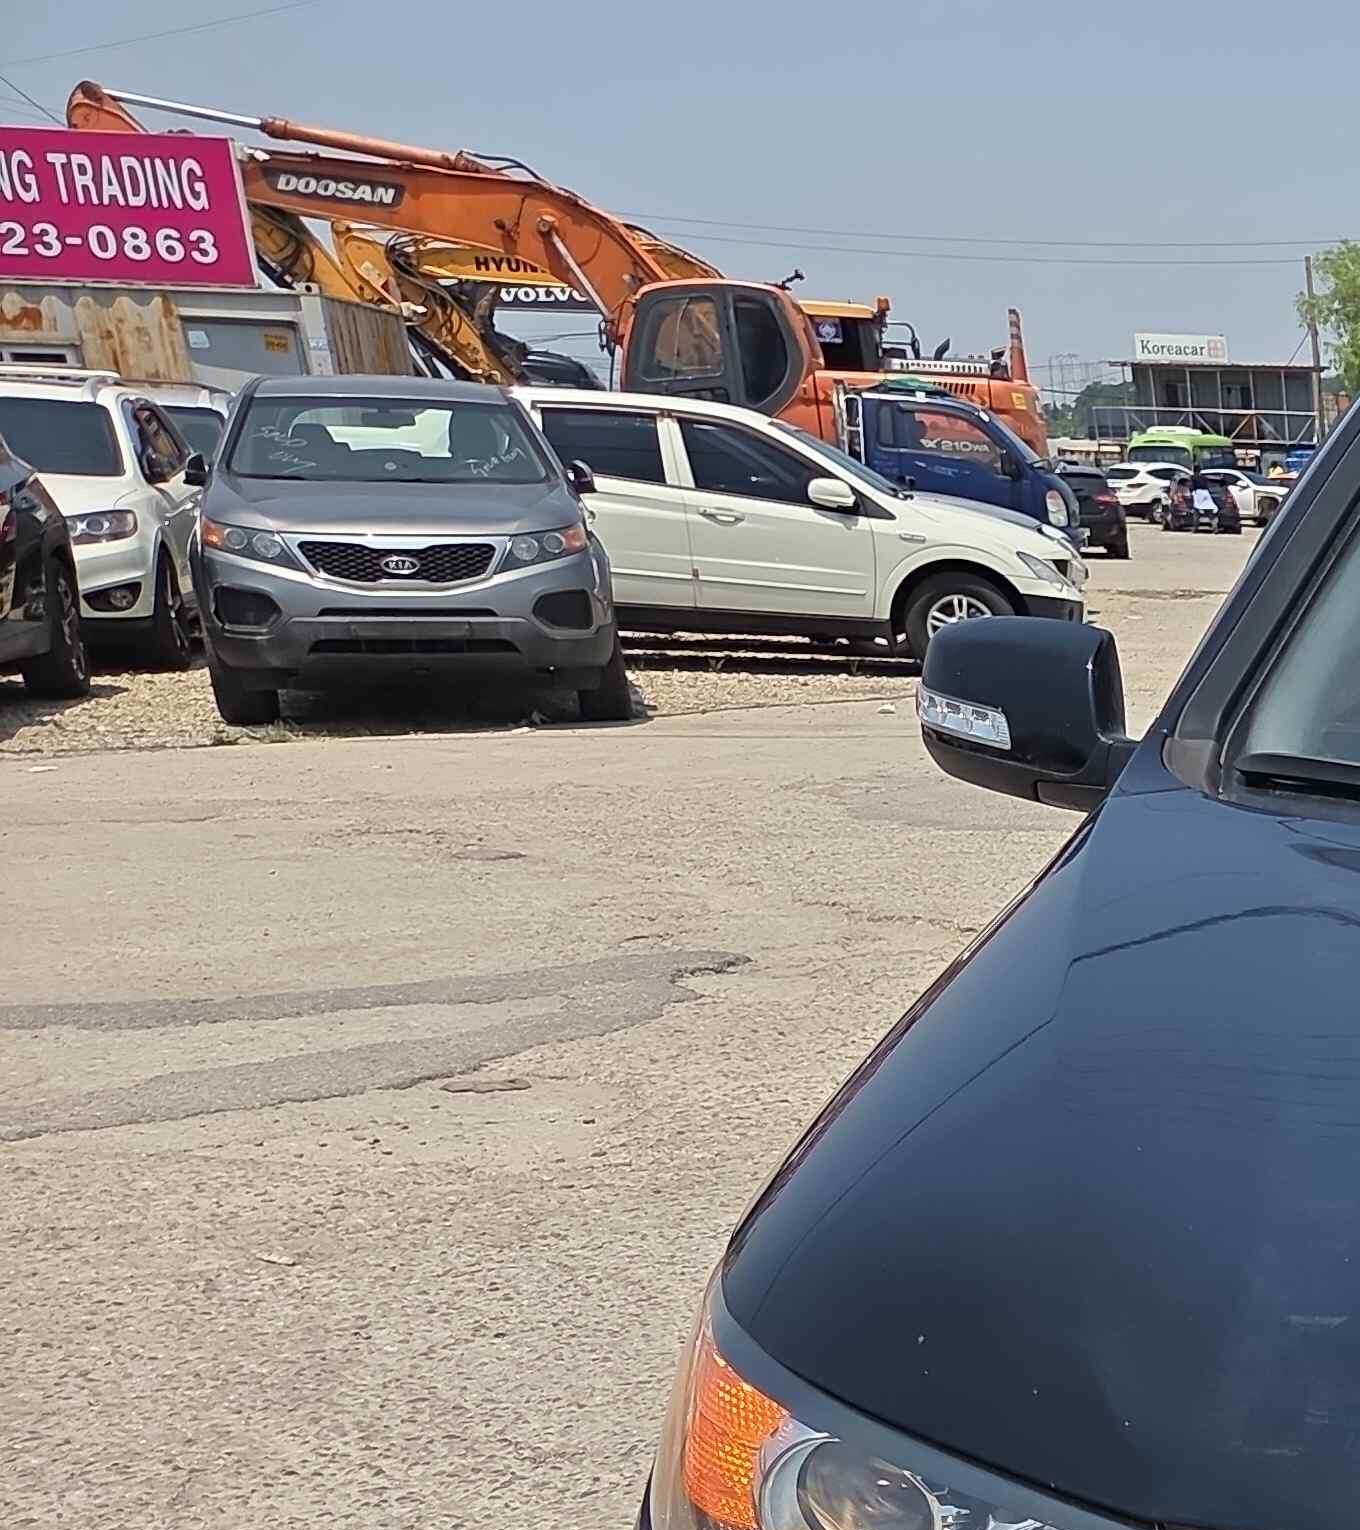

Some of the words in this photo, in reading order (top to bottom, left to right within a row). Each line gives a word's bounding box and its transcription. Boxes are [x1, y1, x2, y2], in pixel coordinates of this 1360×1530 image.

[46, 152, 209, 211] TRADING
[277, 174, 395, 204] DOOSAN
[0, 221, 219, 264] 23-0863
[474, 256, 548, 273] HYUN
[1140, 339, 1206, 356] Koreacar
[389, 561, 413, 569] KIA
